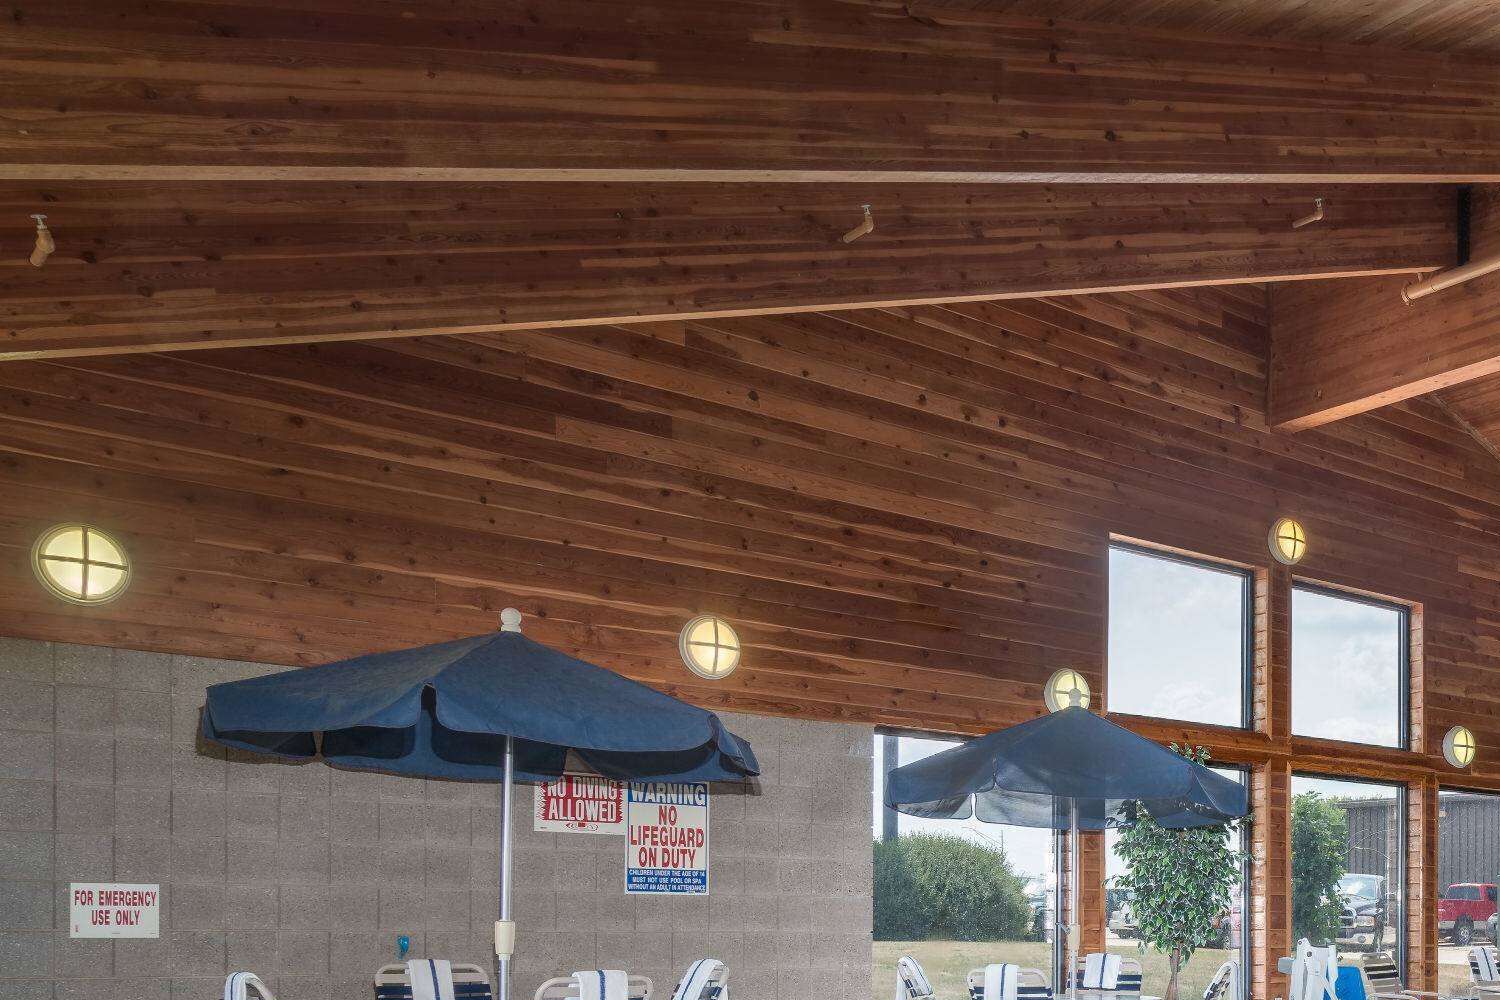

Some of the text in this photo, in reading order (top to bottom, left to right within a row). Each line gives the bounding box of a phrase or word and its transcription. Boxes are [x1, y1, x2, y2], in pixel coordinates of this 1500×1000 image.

[547, 776, 618, 800] NO DIVING
[631, 782, 706, 805] WARNING
[548, 798, 617, 822] ALLOWED
[659, 805, 677, 826] NO
[630, 825, 704, 848] LIFEGUARD
[639, 847, 696, 868] ON DUTY
[74, 890, 156, 906] FOR EMERGENCY
[91, 910, 140, 925] USE ONLY
